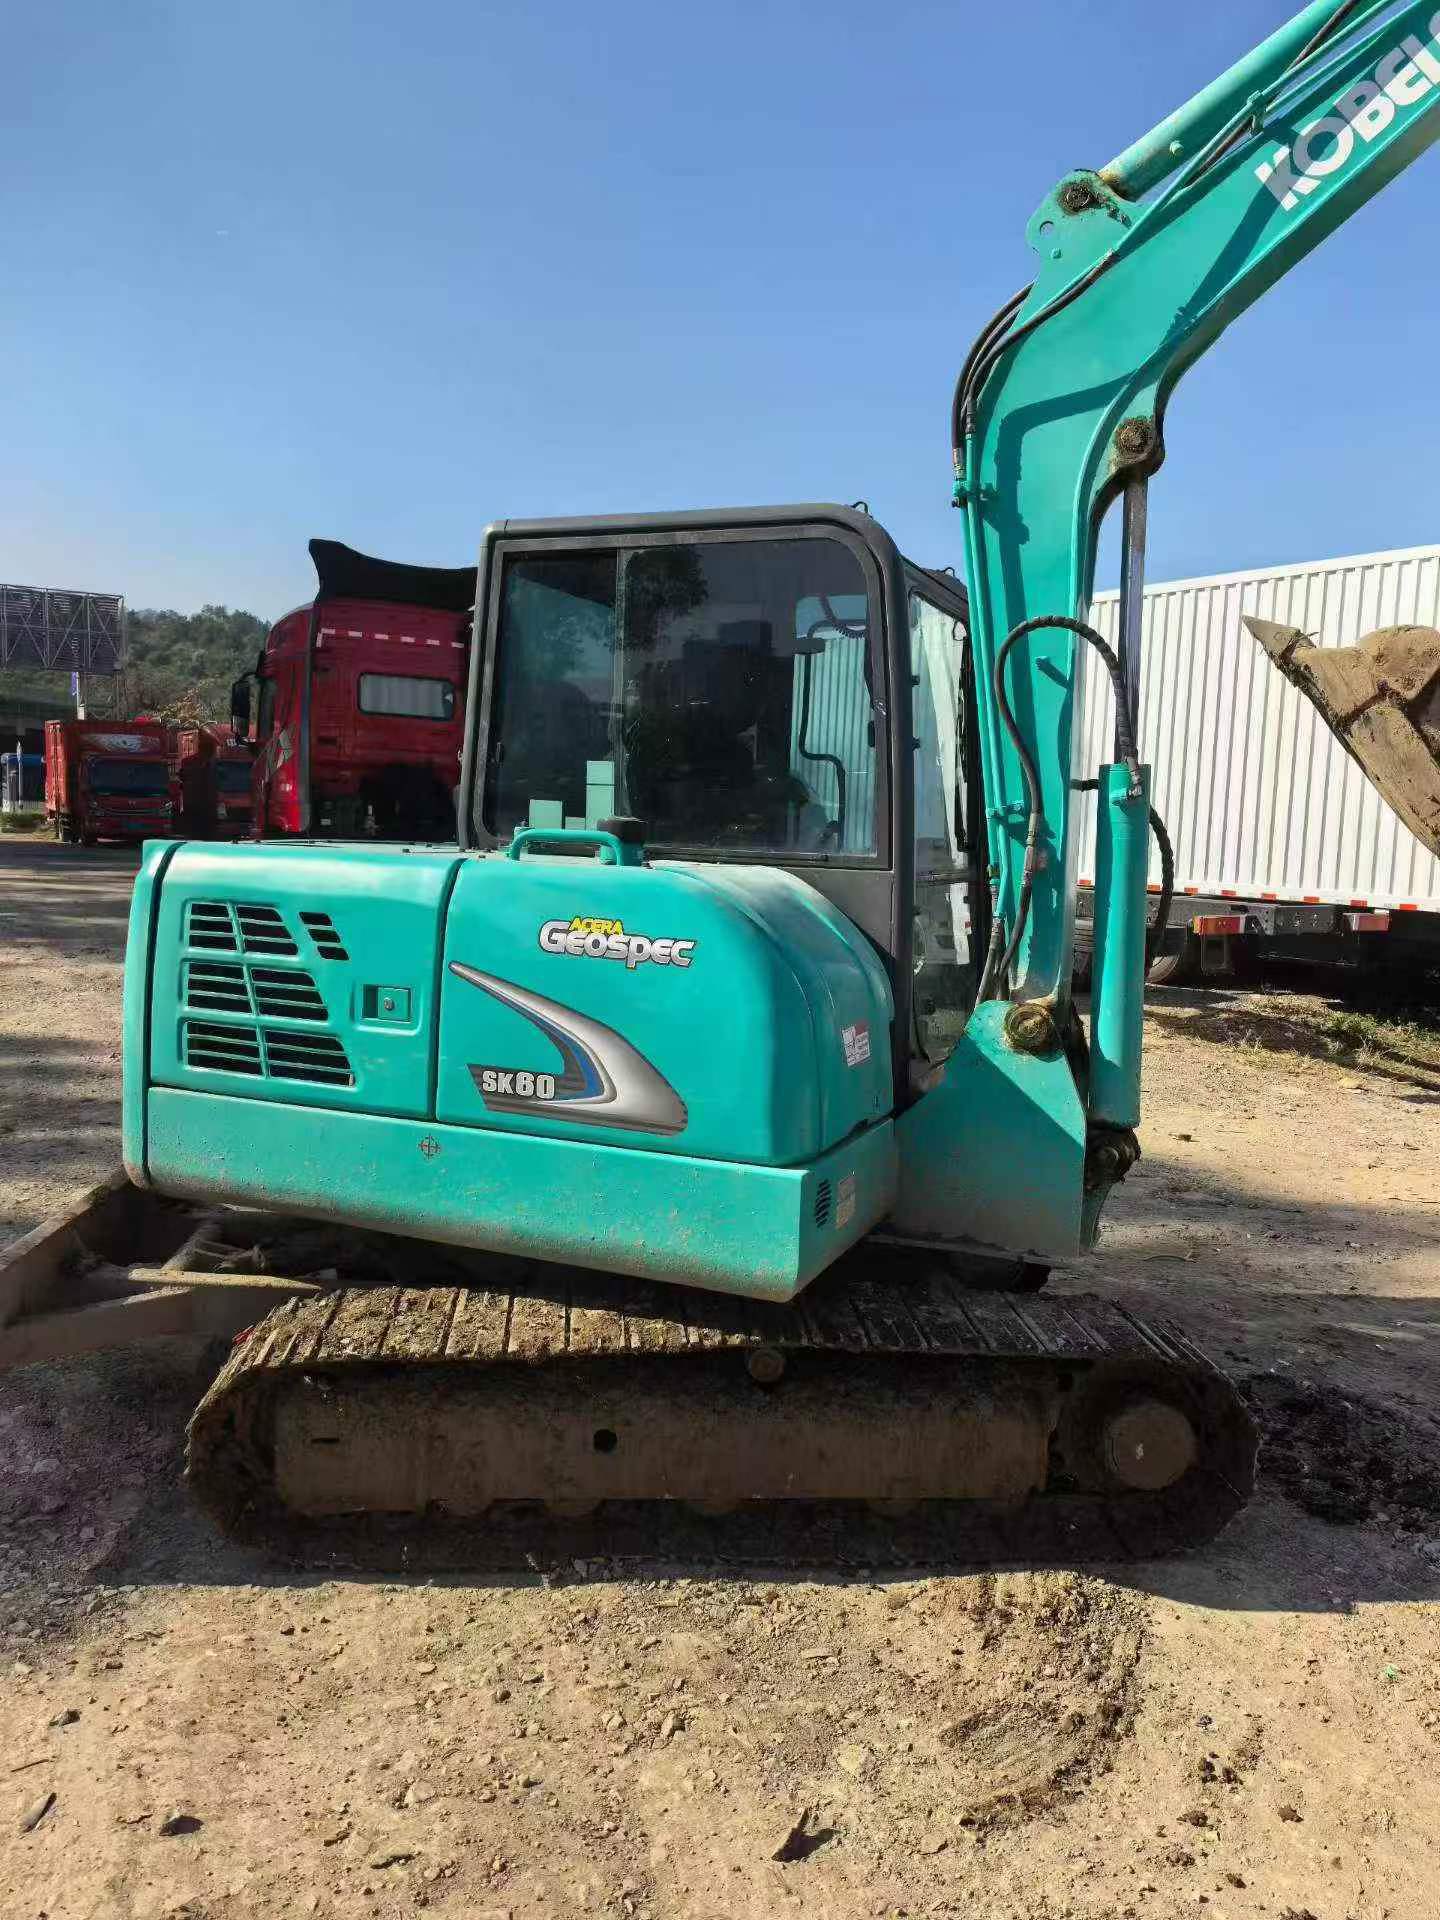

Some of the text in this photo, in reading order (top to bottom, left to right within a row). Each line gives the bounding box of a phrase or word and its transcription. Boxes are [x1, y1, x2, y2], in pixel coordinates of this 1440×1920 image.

[1254, 9, 1440, 211] KOBEL
[568, 916, 624, 937] ACERA
[482, 1069, 555, 1100] SK60
